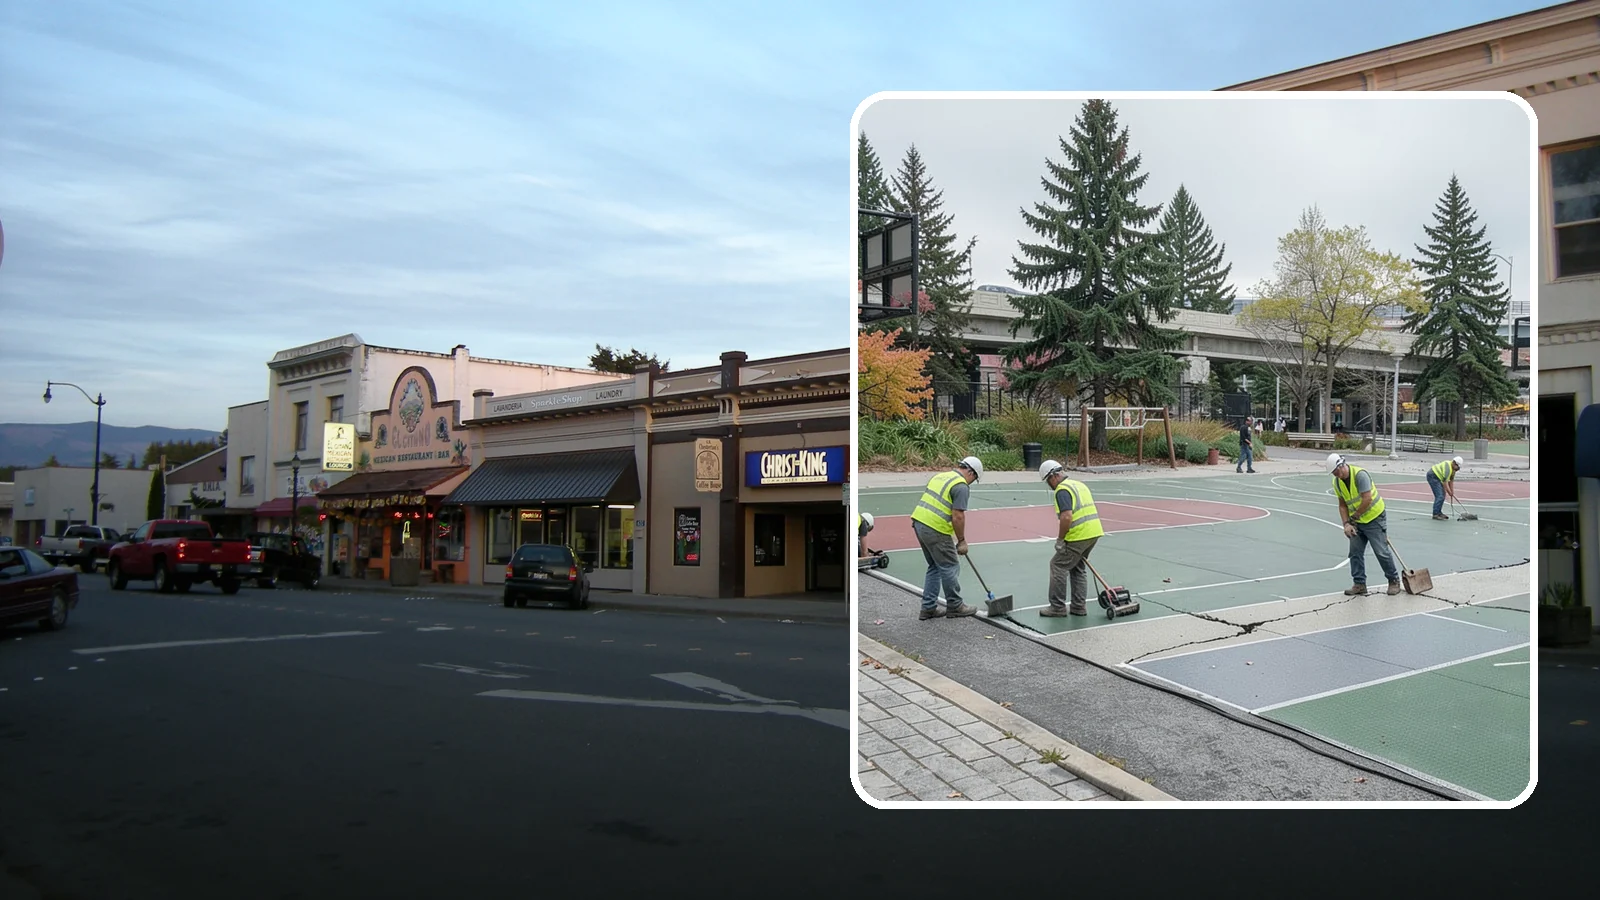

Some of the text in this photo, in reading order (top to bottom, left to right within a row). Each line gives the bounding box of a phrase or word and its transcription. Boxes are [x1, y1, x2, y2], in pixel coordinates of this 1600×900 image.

[595, 388, 623, 400] LAUNDRY
[493, 401, 523, 413] LAVANDERIA
[530, 394, 582, 409] Sparkle Shop
[373, 450, 450, 464] MEXICAN RESTAURANT BAR
[760, 450, 827, 478] CHRIST KING
